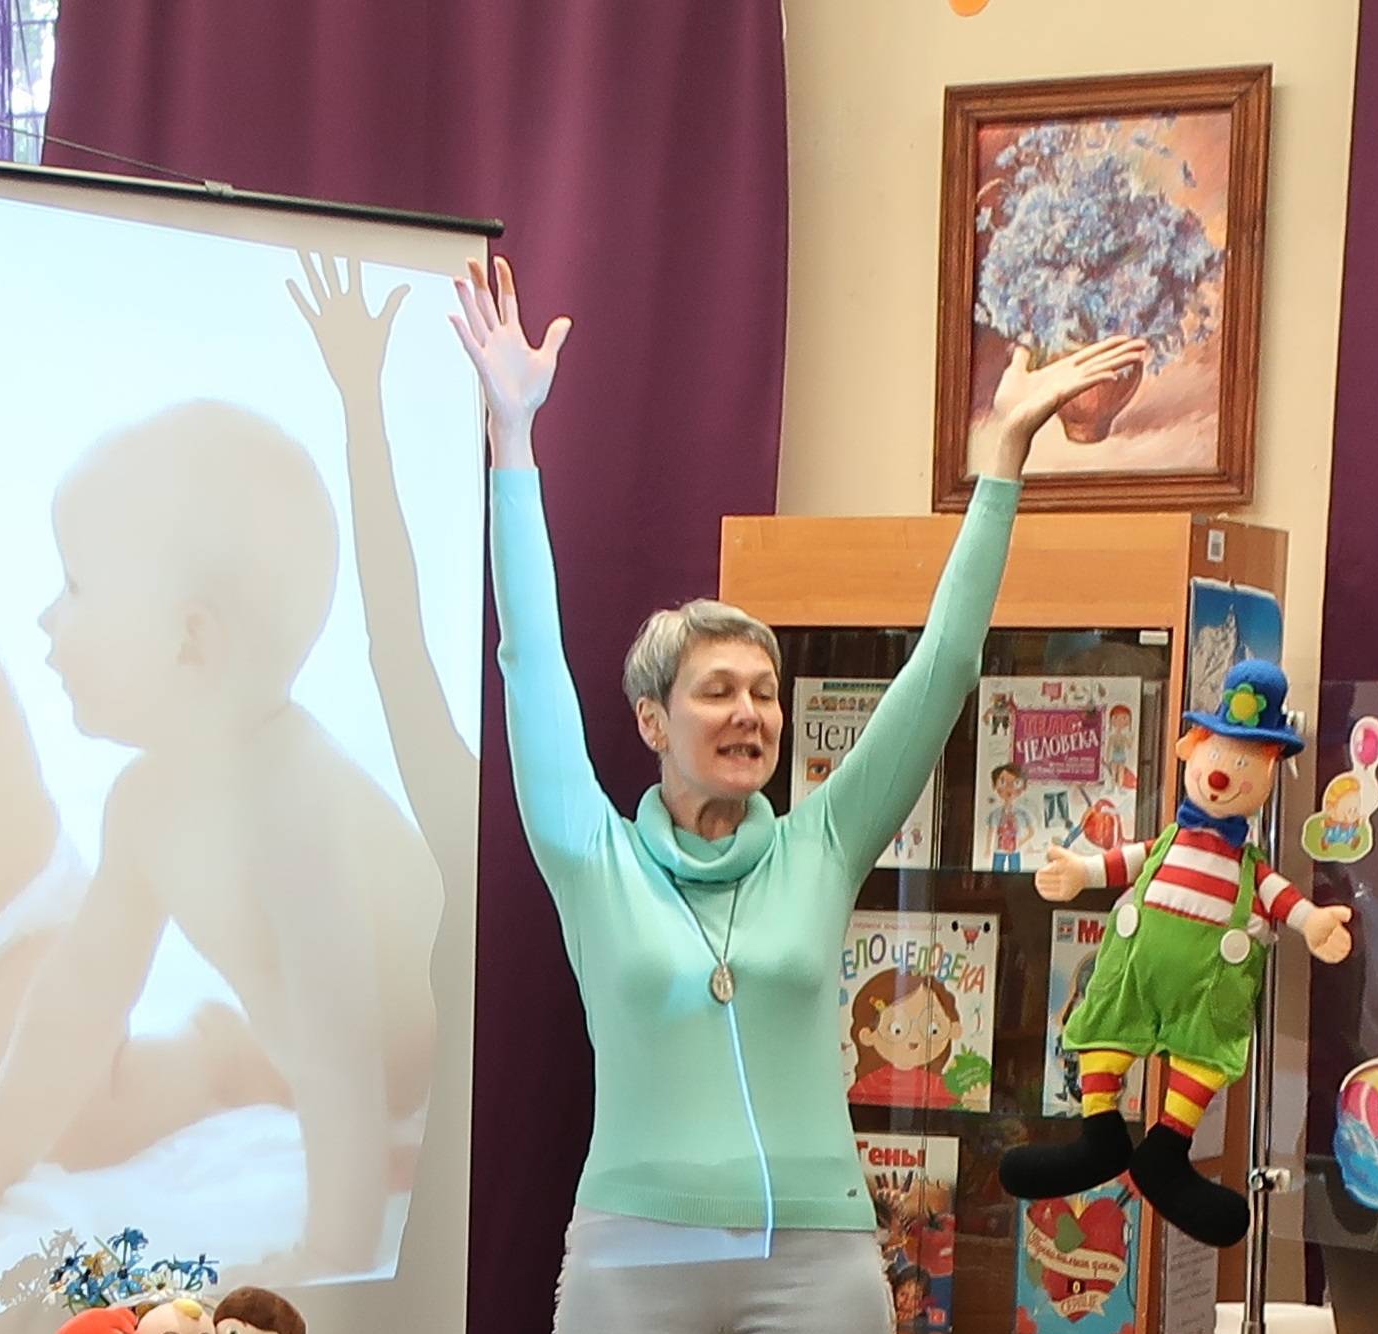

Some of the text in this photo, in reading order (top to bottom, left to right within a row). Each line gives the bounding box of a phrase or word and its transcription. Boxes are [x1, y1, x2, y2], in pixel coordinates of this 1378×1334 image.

[1016, 729, 1099, 764] ЧЕЛОВЕКА
[841, 934, 985, 994] ЕЛО ЧЕЛОВЕКА
